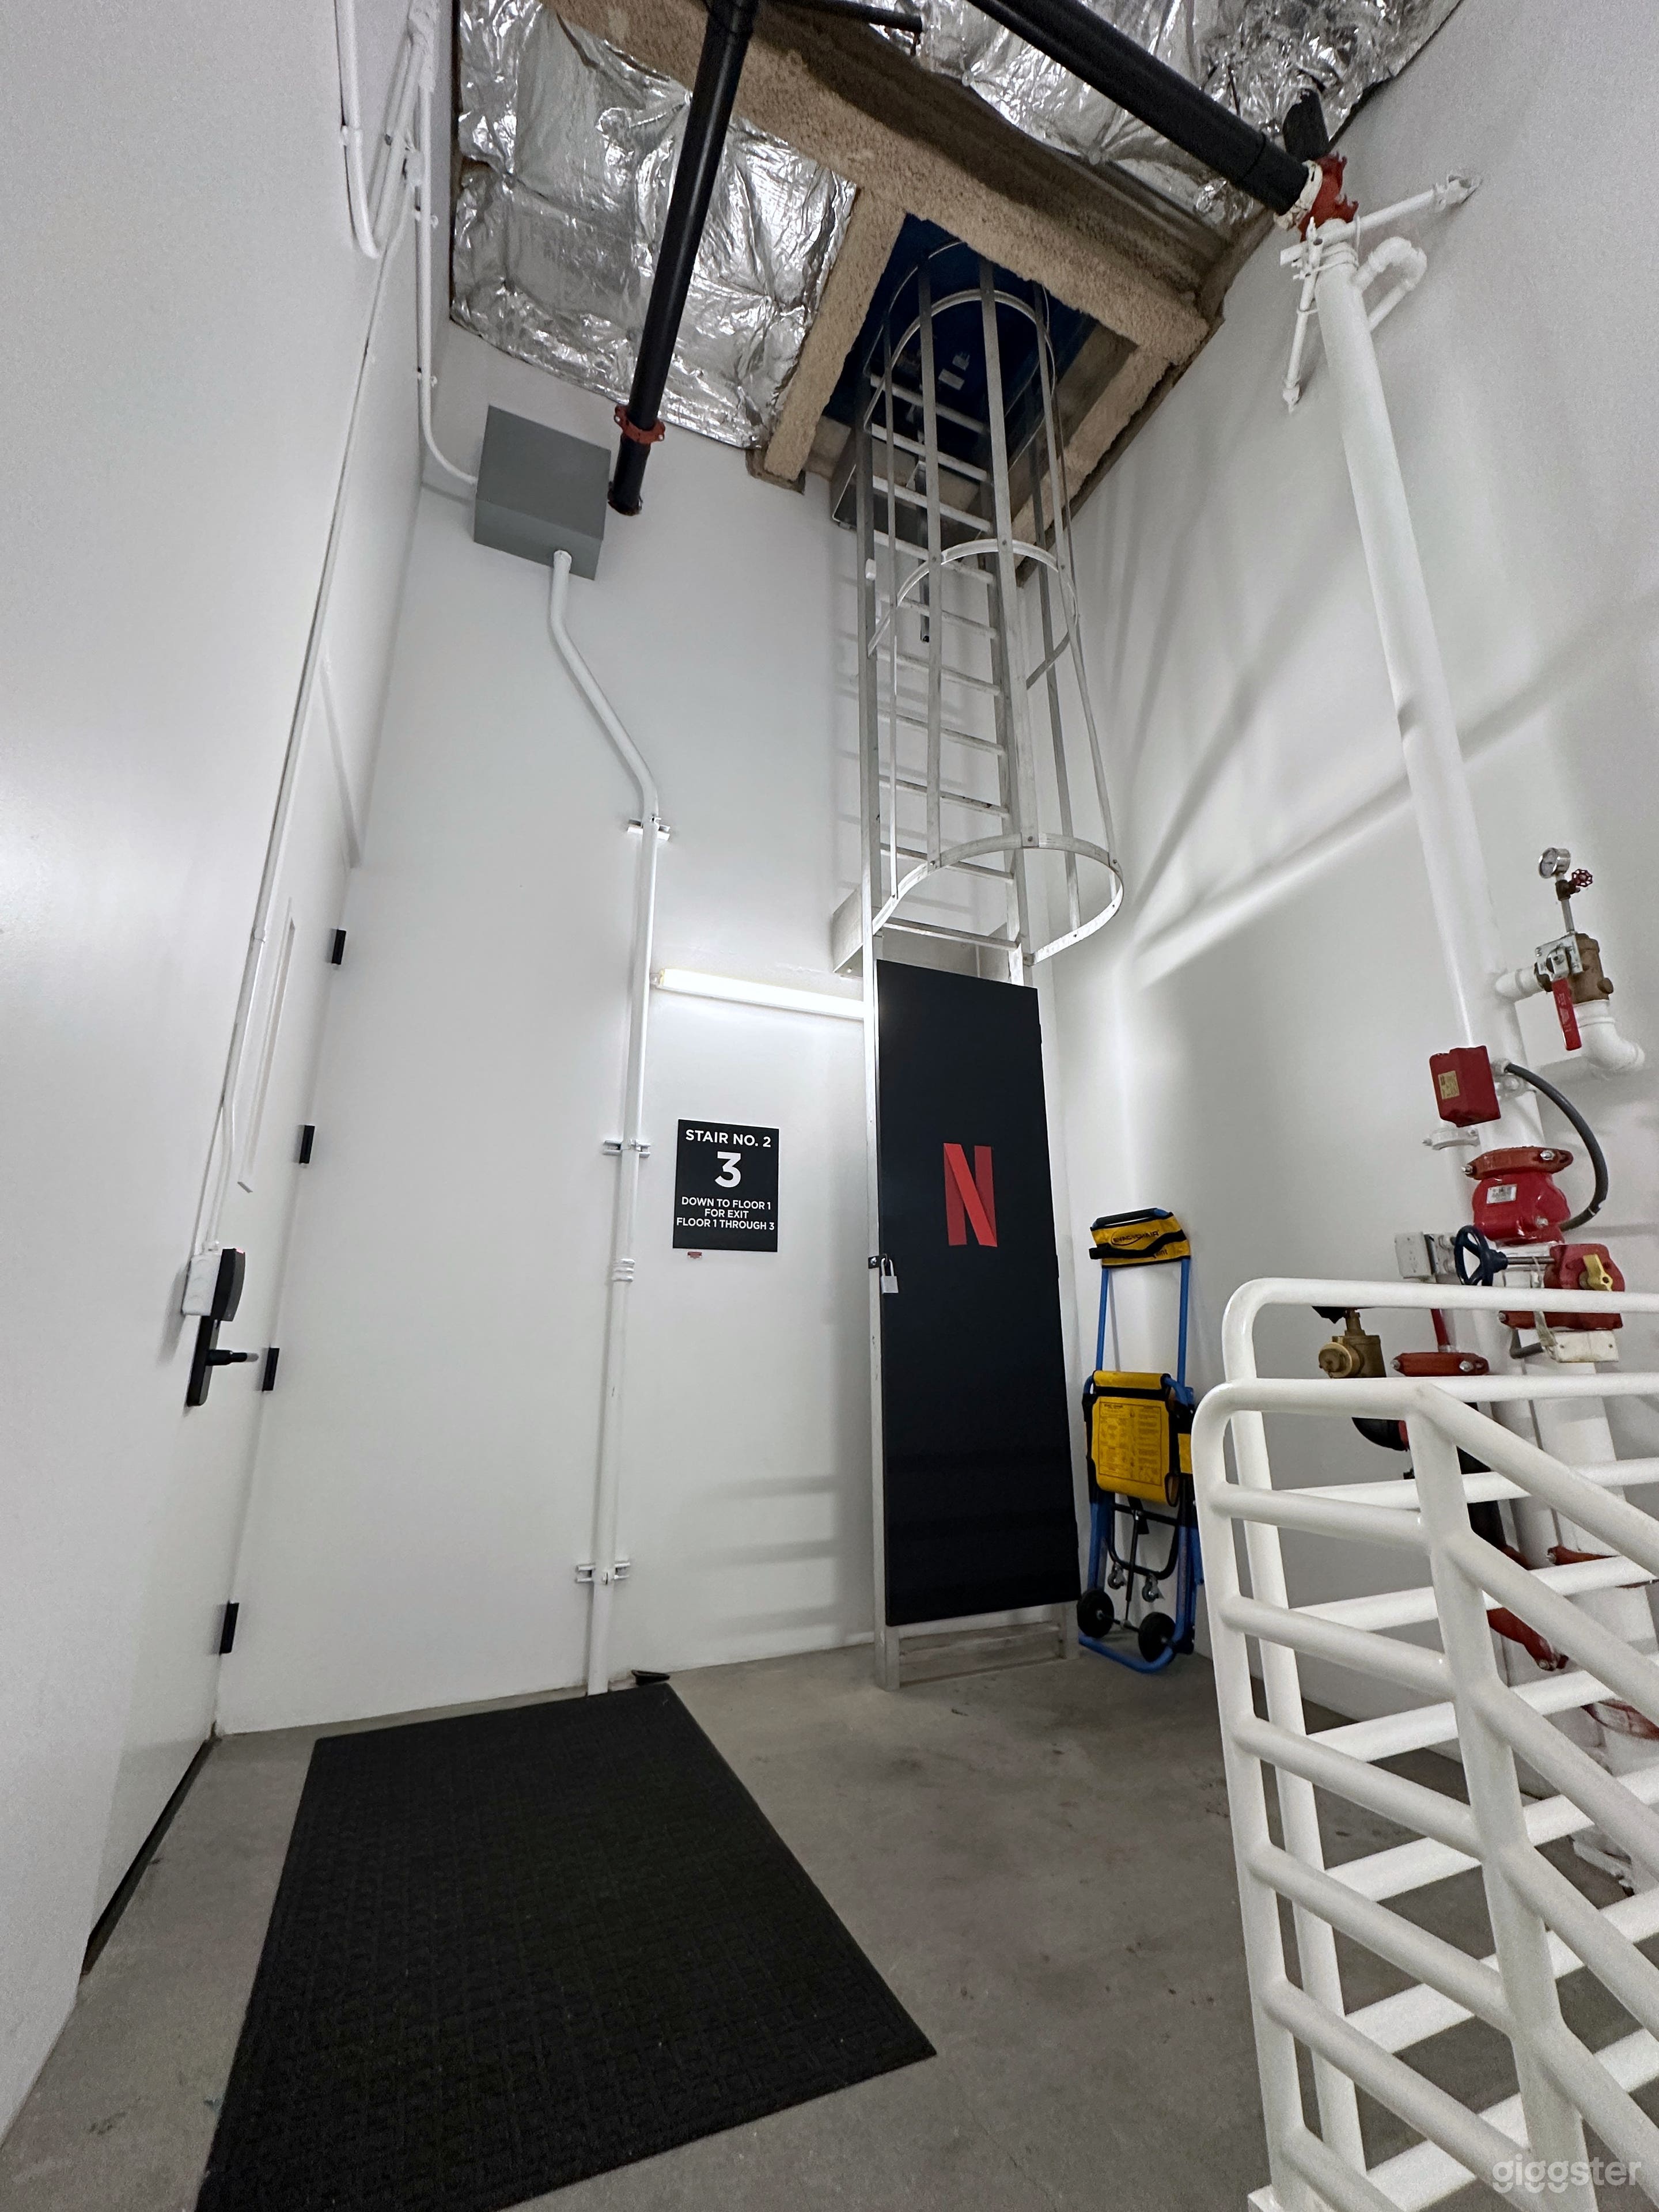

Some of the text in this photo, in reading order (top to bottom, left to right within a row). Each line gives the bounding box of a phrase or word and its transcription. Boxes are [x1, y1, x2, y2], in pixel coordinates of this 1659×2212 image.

[685, 1129, 771, 1147] STAIR NO. 2
[714, 1151, 741, 1188] 3
[944, 1142, 998, 1247] N
[681, 1196, 771, 1210] DOWN TO FLOOR 1
[704, 1208, 749, 1219] FOR EXIT
[676, 1217, 775, 1230] FLOOR 1 THROUGH 3
